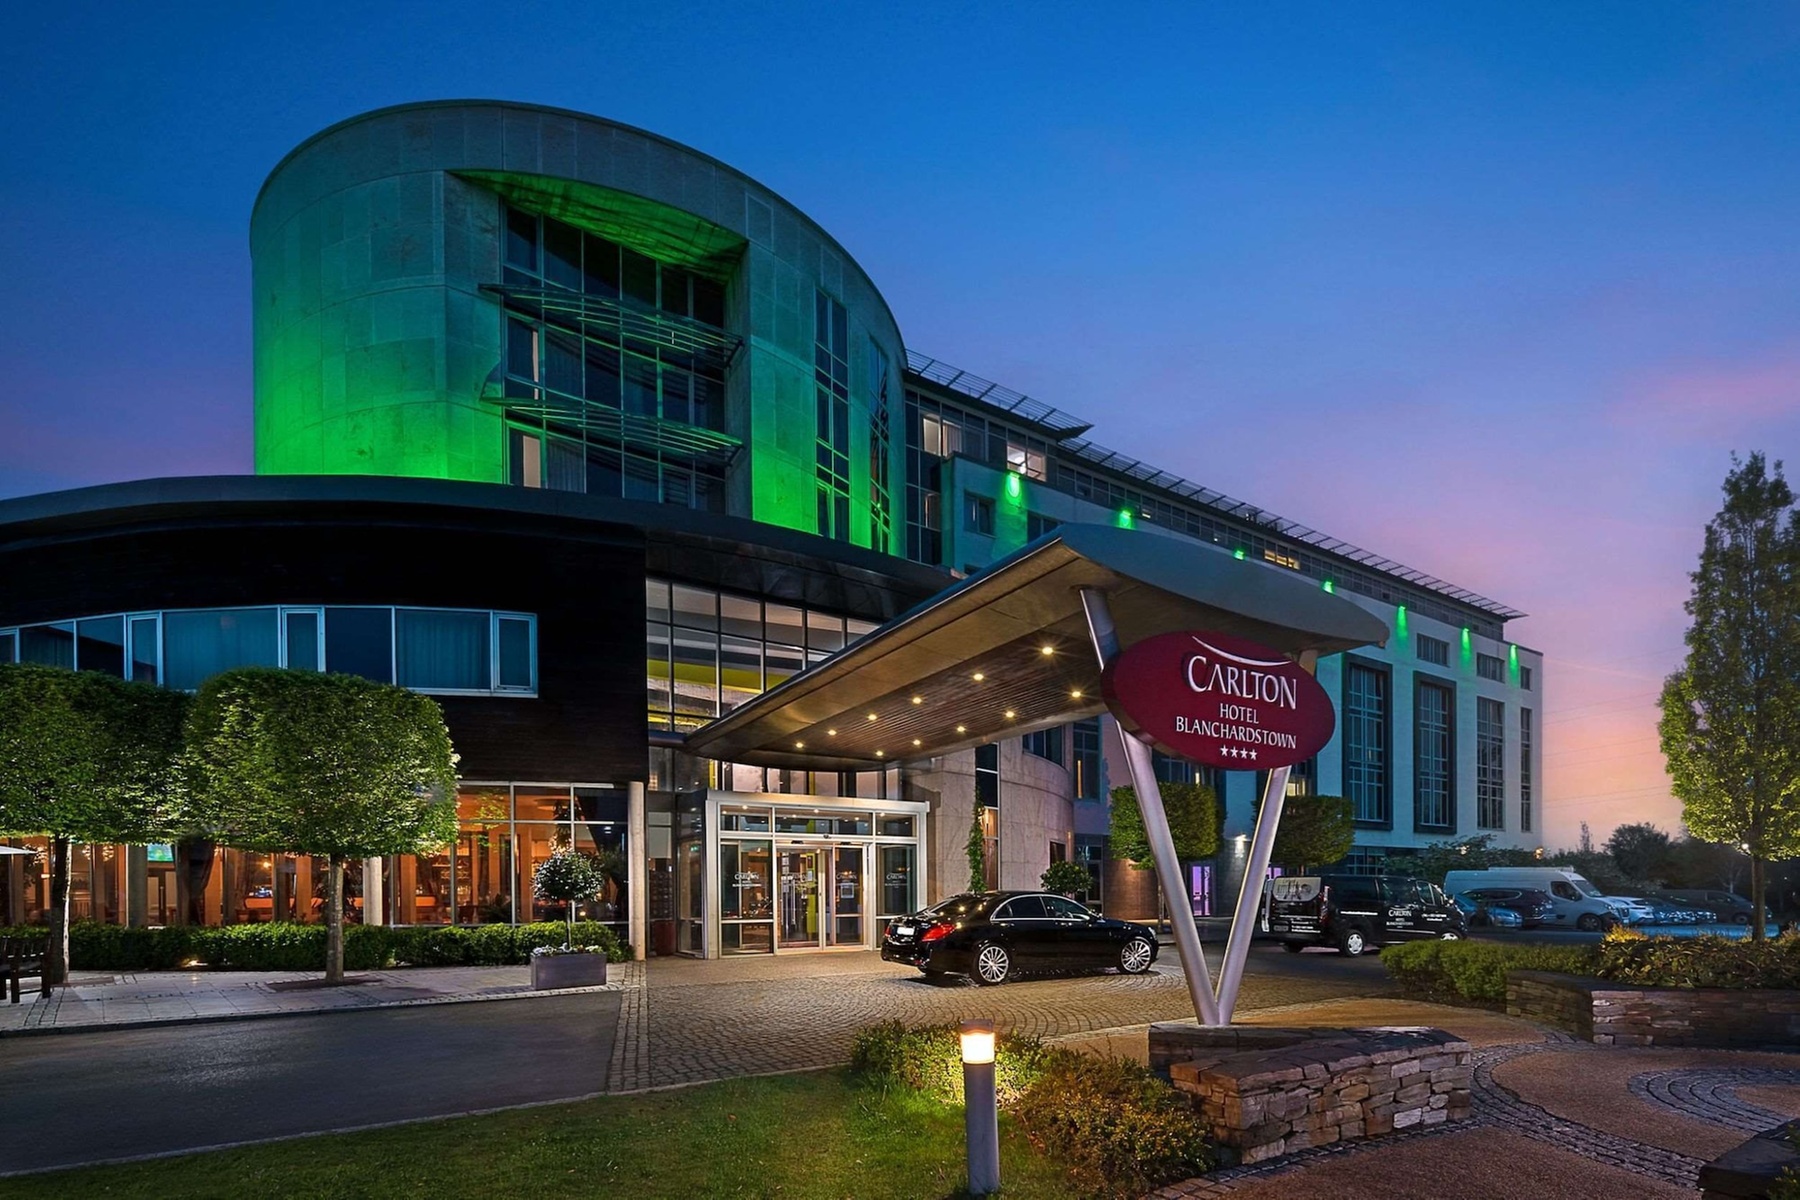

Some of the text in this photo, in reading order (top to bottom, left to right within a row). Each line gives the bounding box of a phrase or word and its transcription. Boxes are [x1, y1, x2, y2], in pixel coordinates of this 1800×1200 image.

[1187, 655, 1297, 710] CARLTON
[1219, 703, 1259, 724] HOTEL
[1175, 716, 1297, 749] BLANCHARDSTOWN
